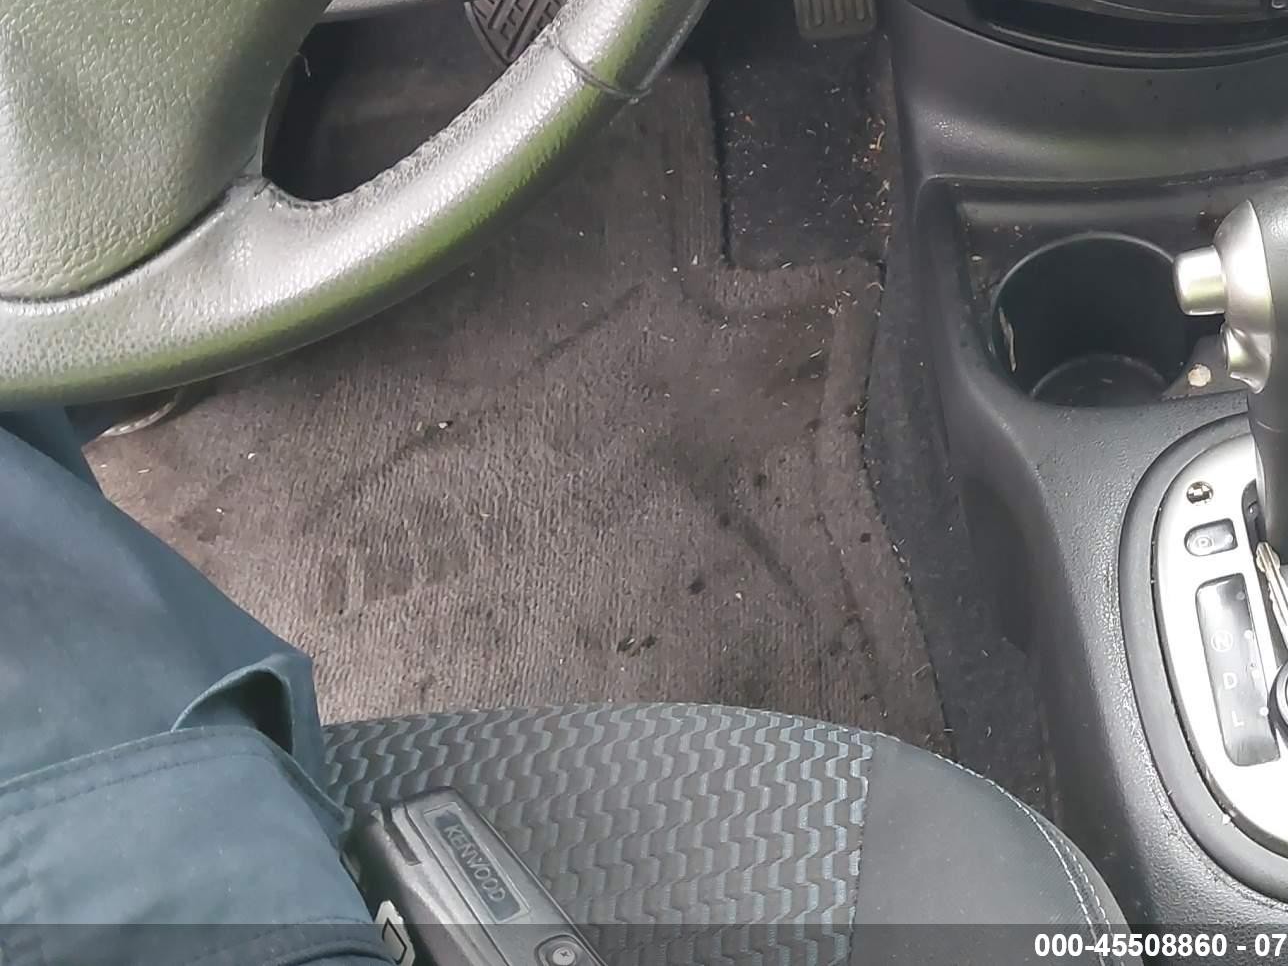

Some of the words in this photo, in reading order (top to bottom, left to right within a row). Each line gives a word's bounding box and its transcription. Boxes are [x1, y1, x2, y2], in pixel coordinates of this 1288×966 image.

[1223, 672, 1238, 689] D
[1231, 710, 1245, 727] L
[443, 825, 506, 902] KENWOOD
